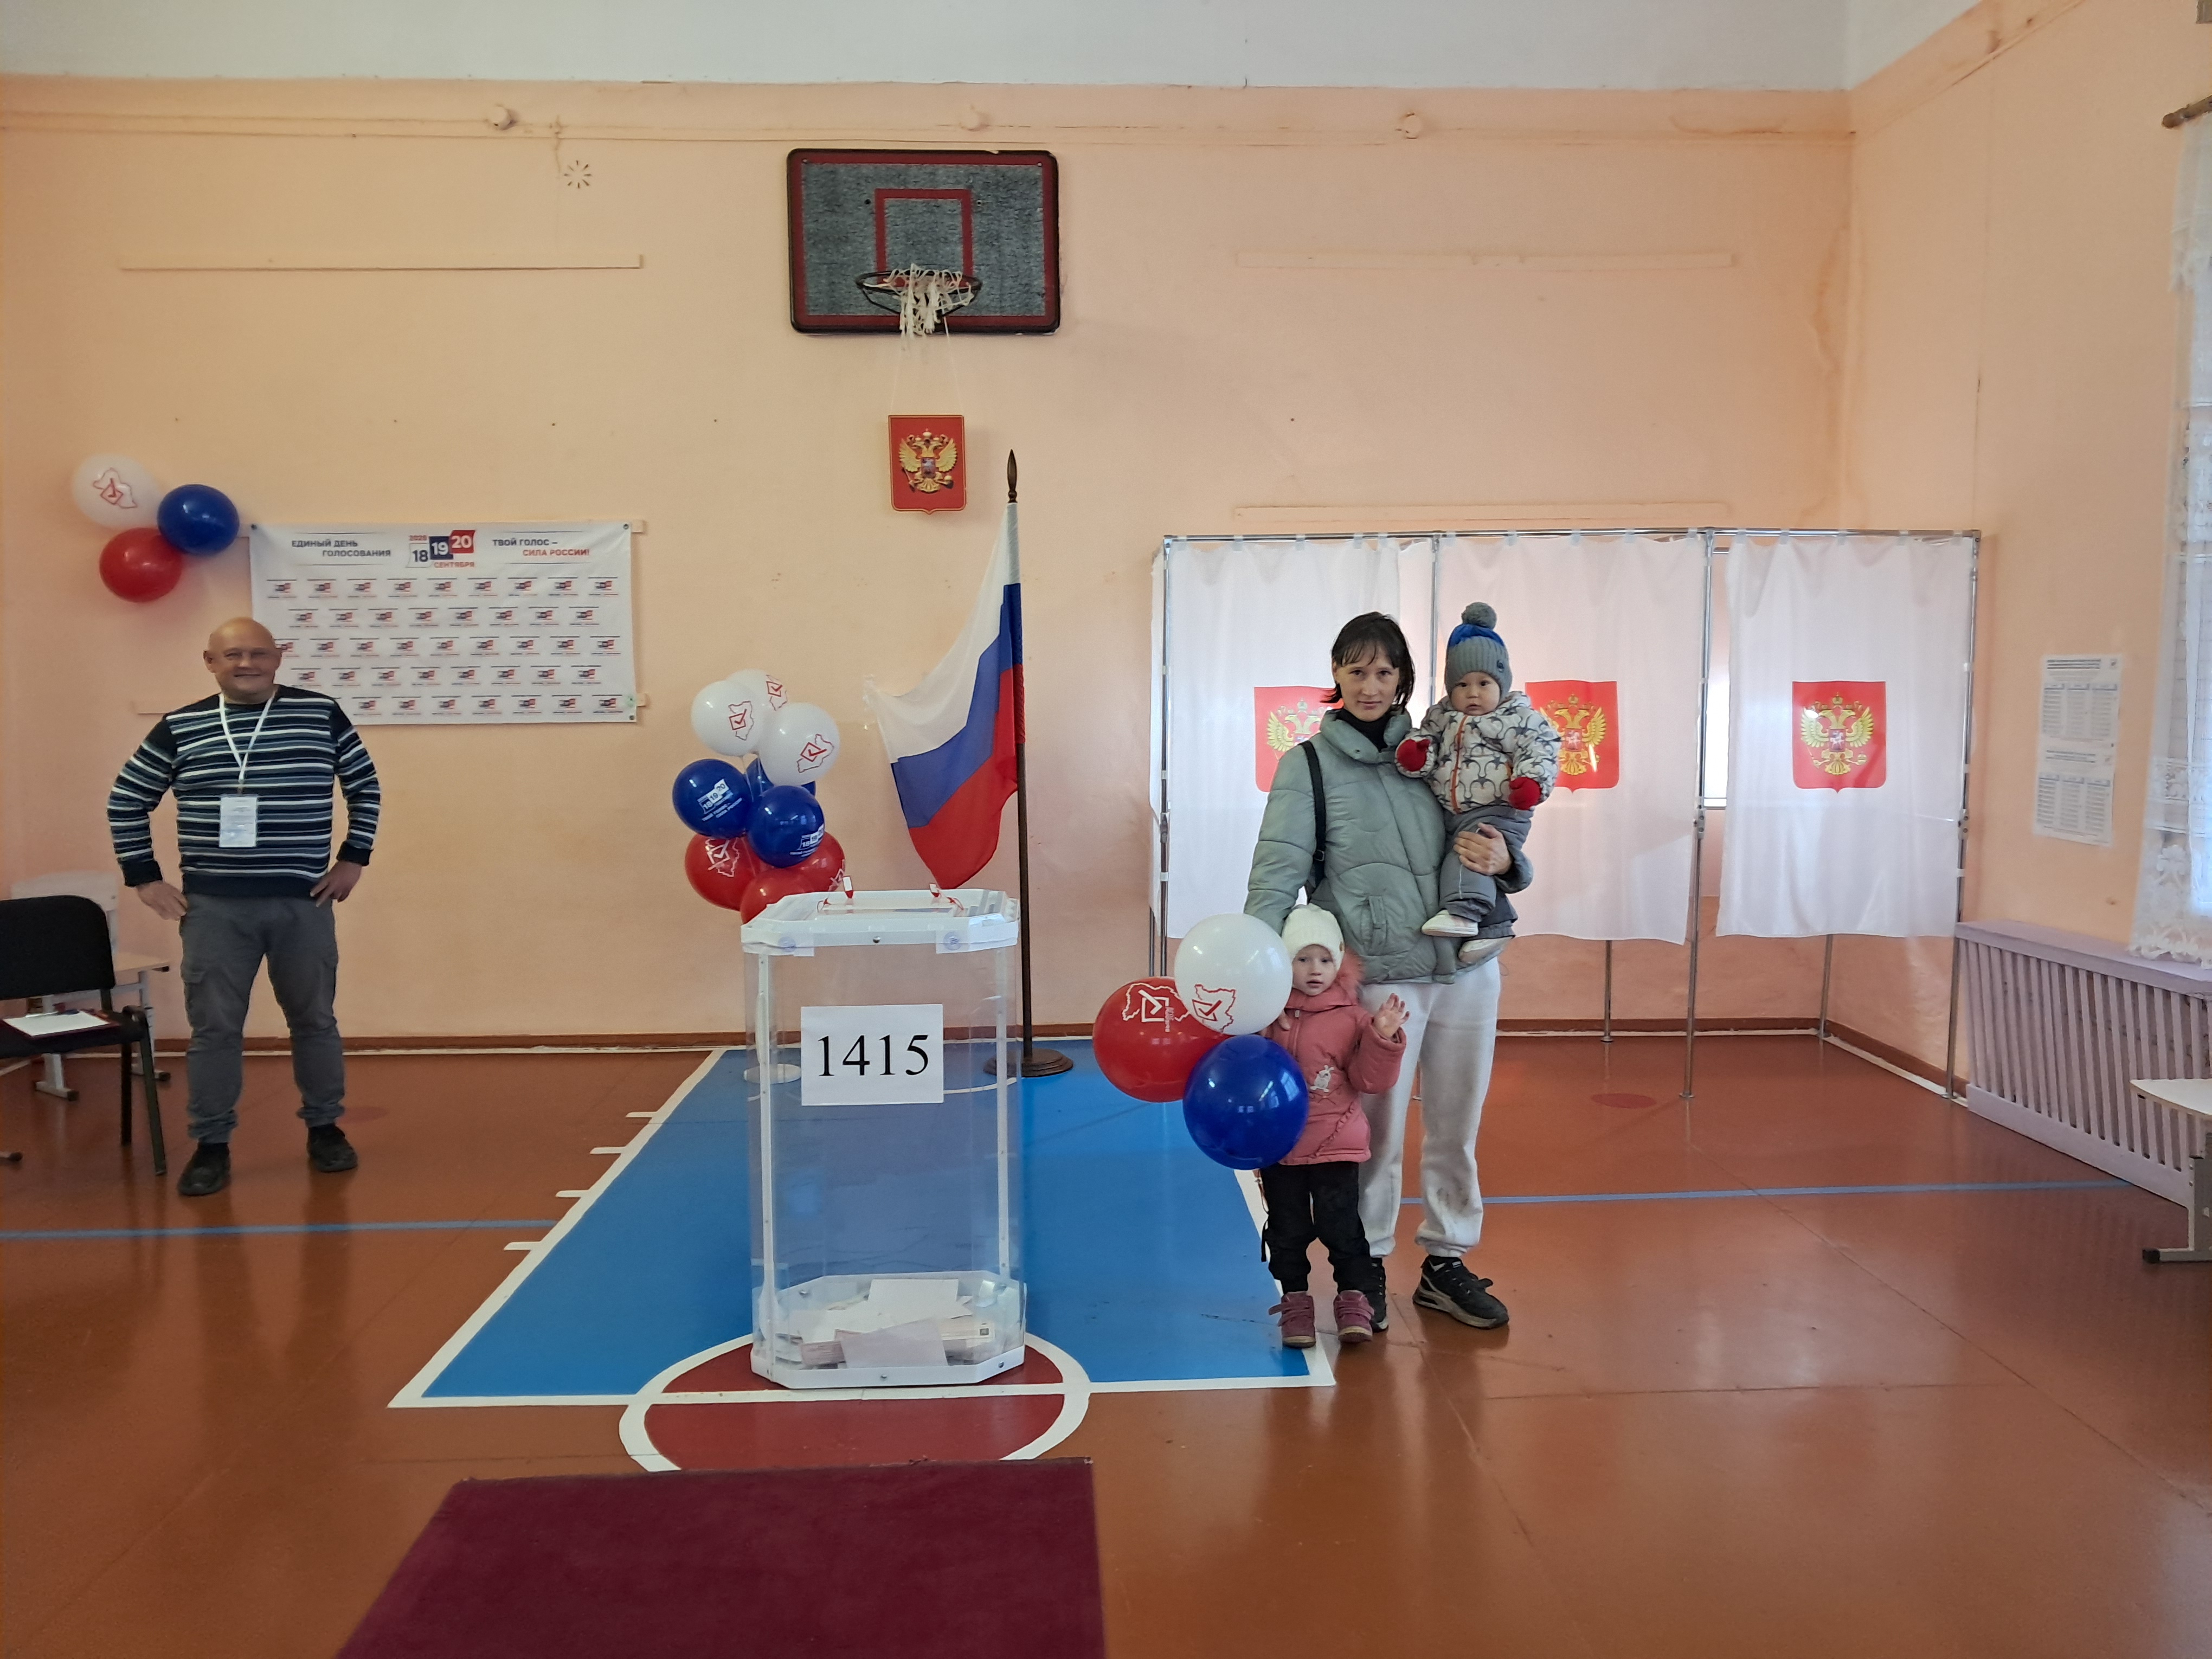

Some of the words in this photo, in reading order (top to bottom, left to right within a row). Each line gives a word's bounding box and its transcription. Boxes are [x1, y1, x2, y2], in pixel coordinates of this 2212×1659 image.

[292, 538, 331, 547] ЕДИНЫЙ
[412, 550, 428, 562] 18
[431, 542, 449, 555] 19
[451, 535, 472, 548] 20
[492, 537, 517, 546] ТВОЙ
[703, 801, 713, 809] 18
[709, 792, 718, 800] 19
[716, 783, 725, 792] 20
[818, 1034, 929, 1077] 1415
